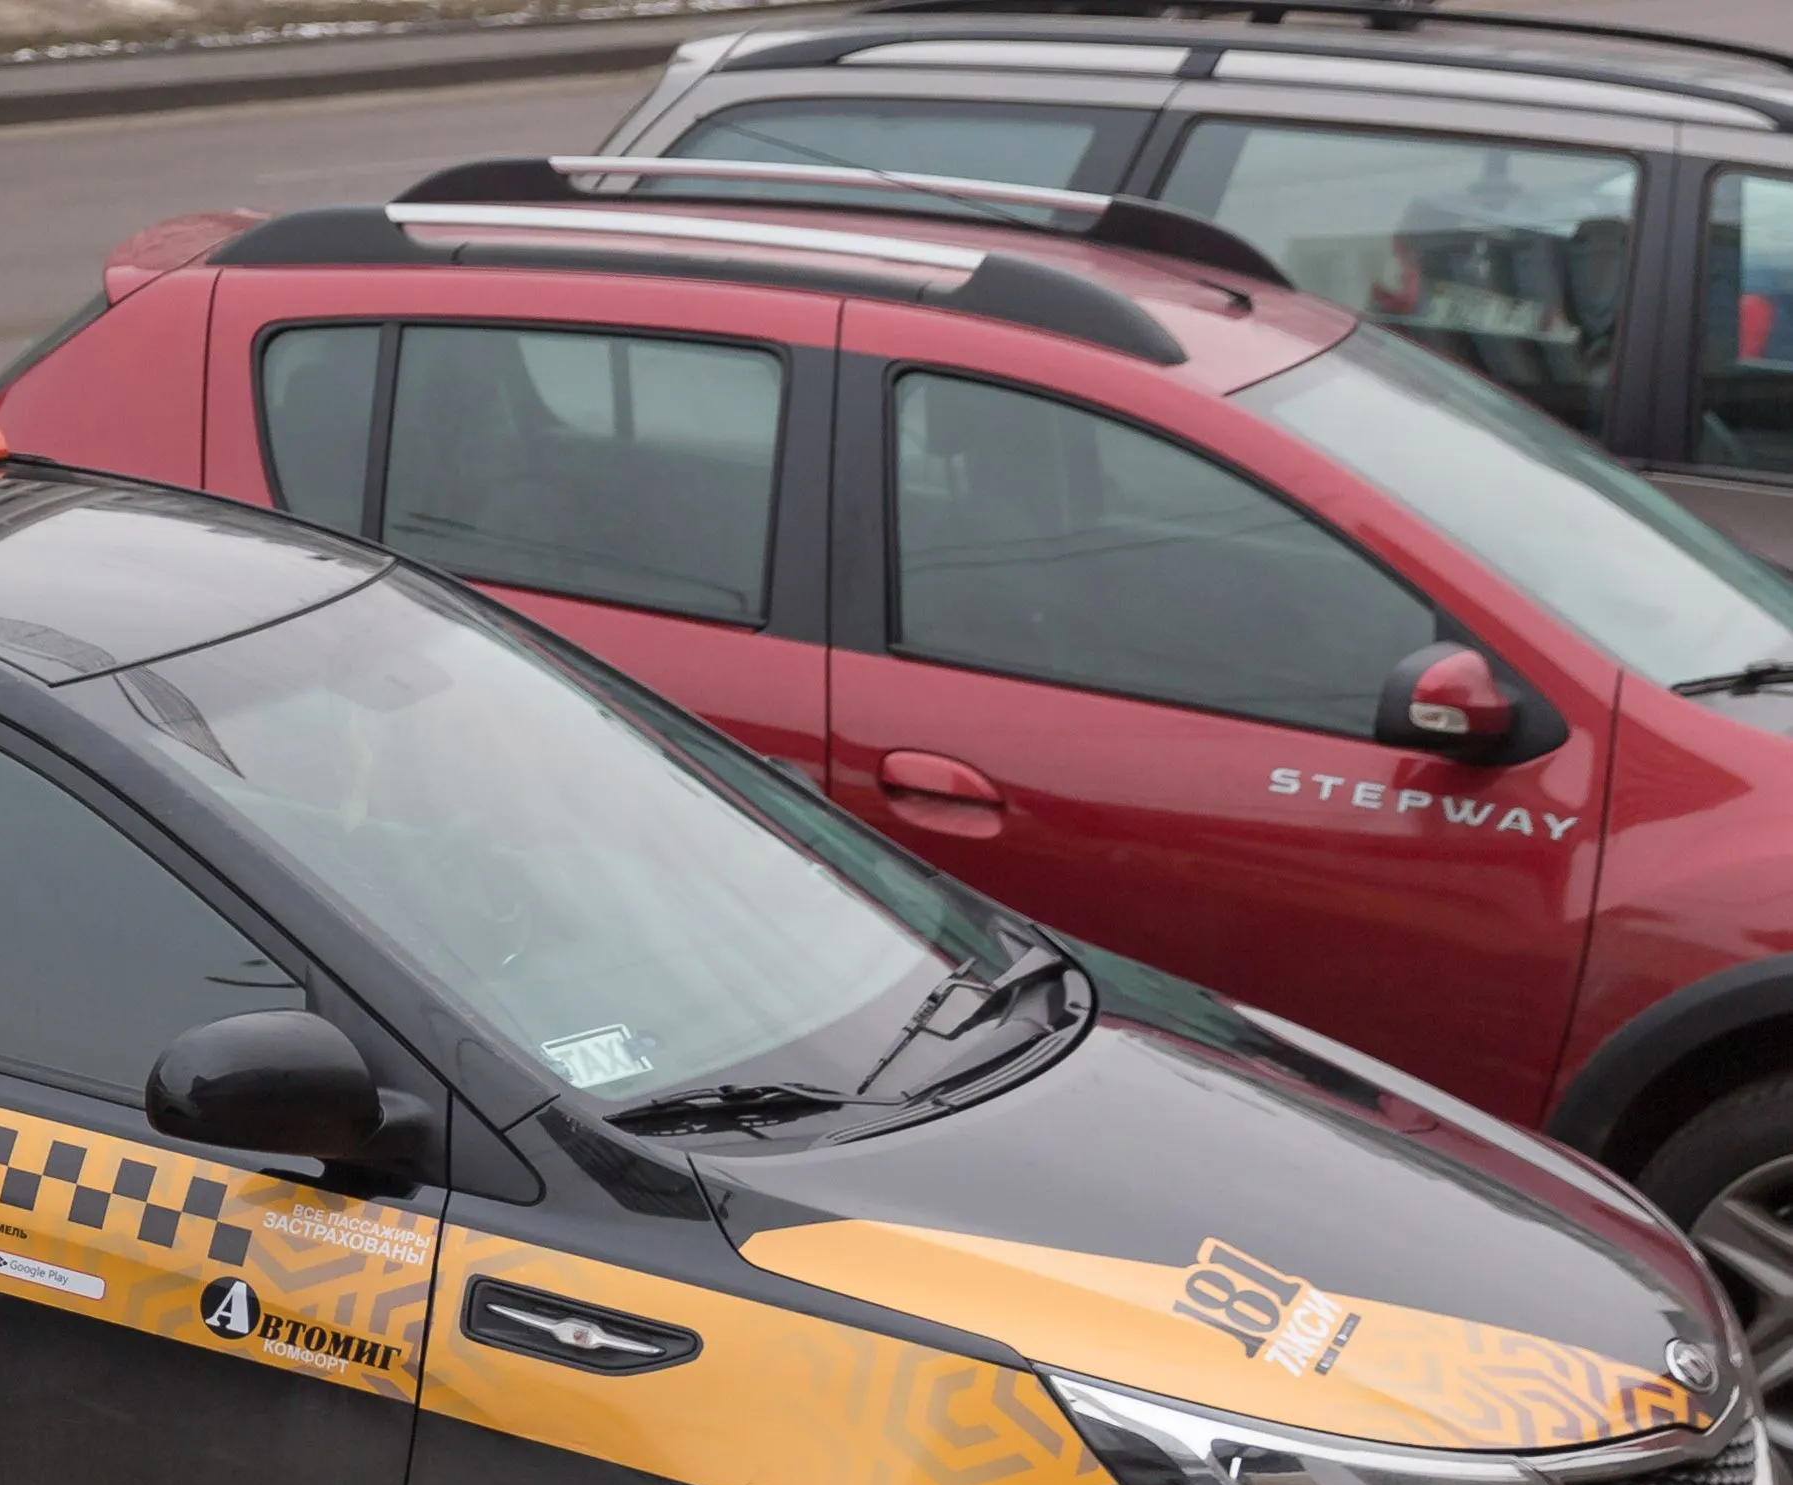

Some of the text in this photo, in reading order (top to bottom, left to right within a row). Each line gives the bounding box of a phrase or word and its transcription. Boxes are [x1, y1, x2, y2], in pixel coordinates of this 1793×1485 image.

[1268, 767, 1580, 841] STEPWAY
[262, 1211, 426, 1266] ЗАСТРАХОВАНЫ
[293, 1203, 431, 1249] ВСЕ ПАССАЖИРЫ
[9, 1252, 69, 1286] Google Play
[1173, 1244, 1302, 1359] 181
[263, 1338, 349, 1374] КОМФОРТ
[1264, 1287, 1342, 1378] ТАКСИ
